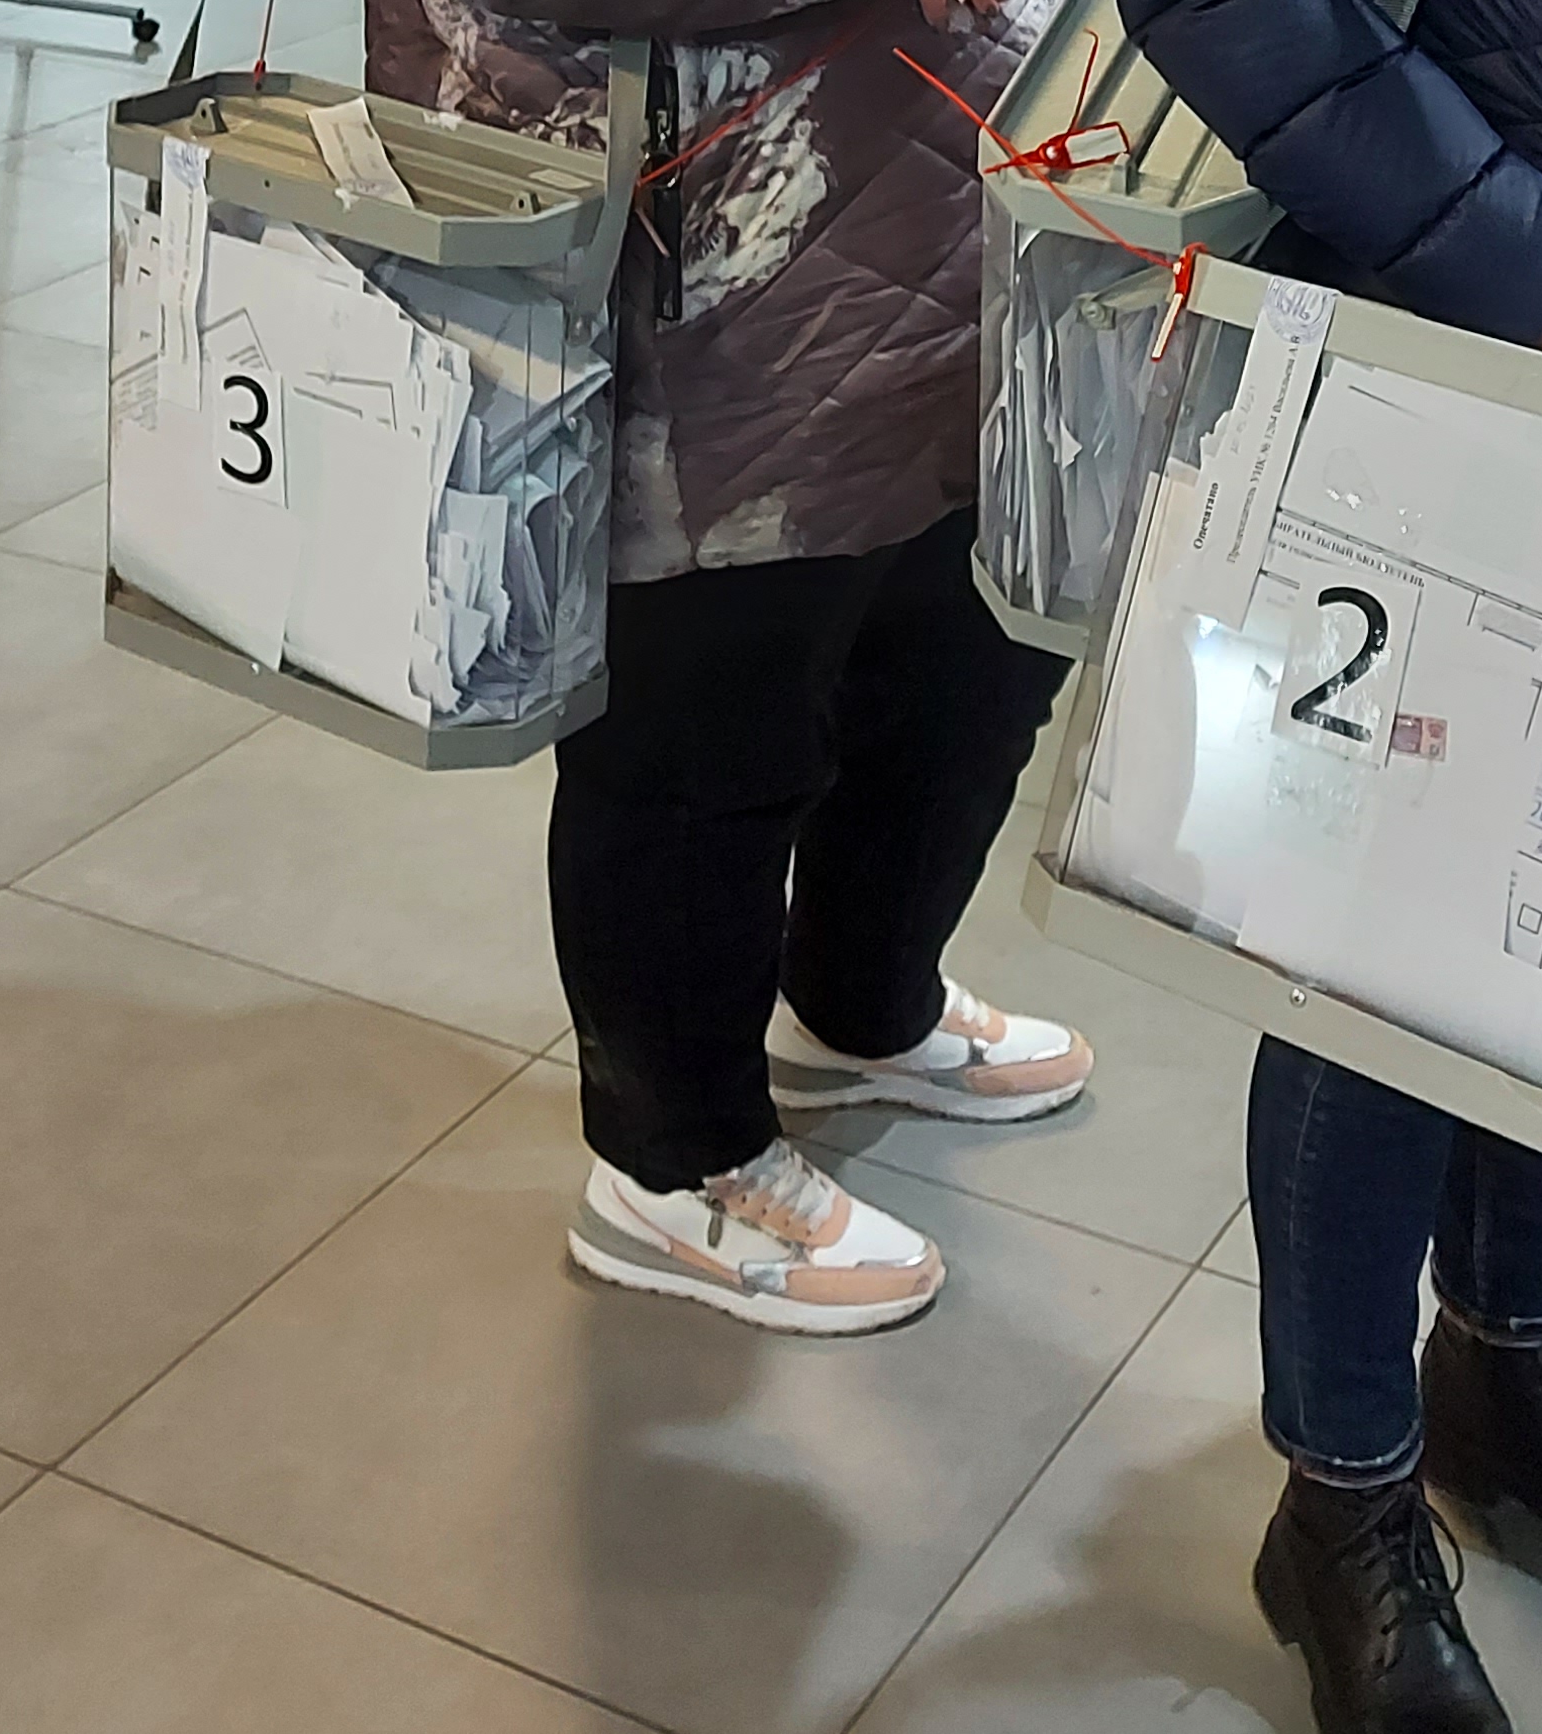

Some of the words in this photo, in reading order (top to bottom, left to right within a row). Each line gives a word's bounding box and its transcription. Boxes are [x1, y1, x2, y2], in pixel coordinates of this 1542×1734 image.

[219, 375, 274, 485] 3
[1192, 482, 1219, 550] Опечатано
[1290, 585, 1388, 743] 2
